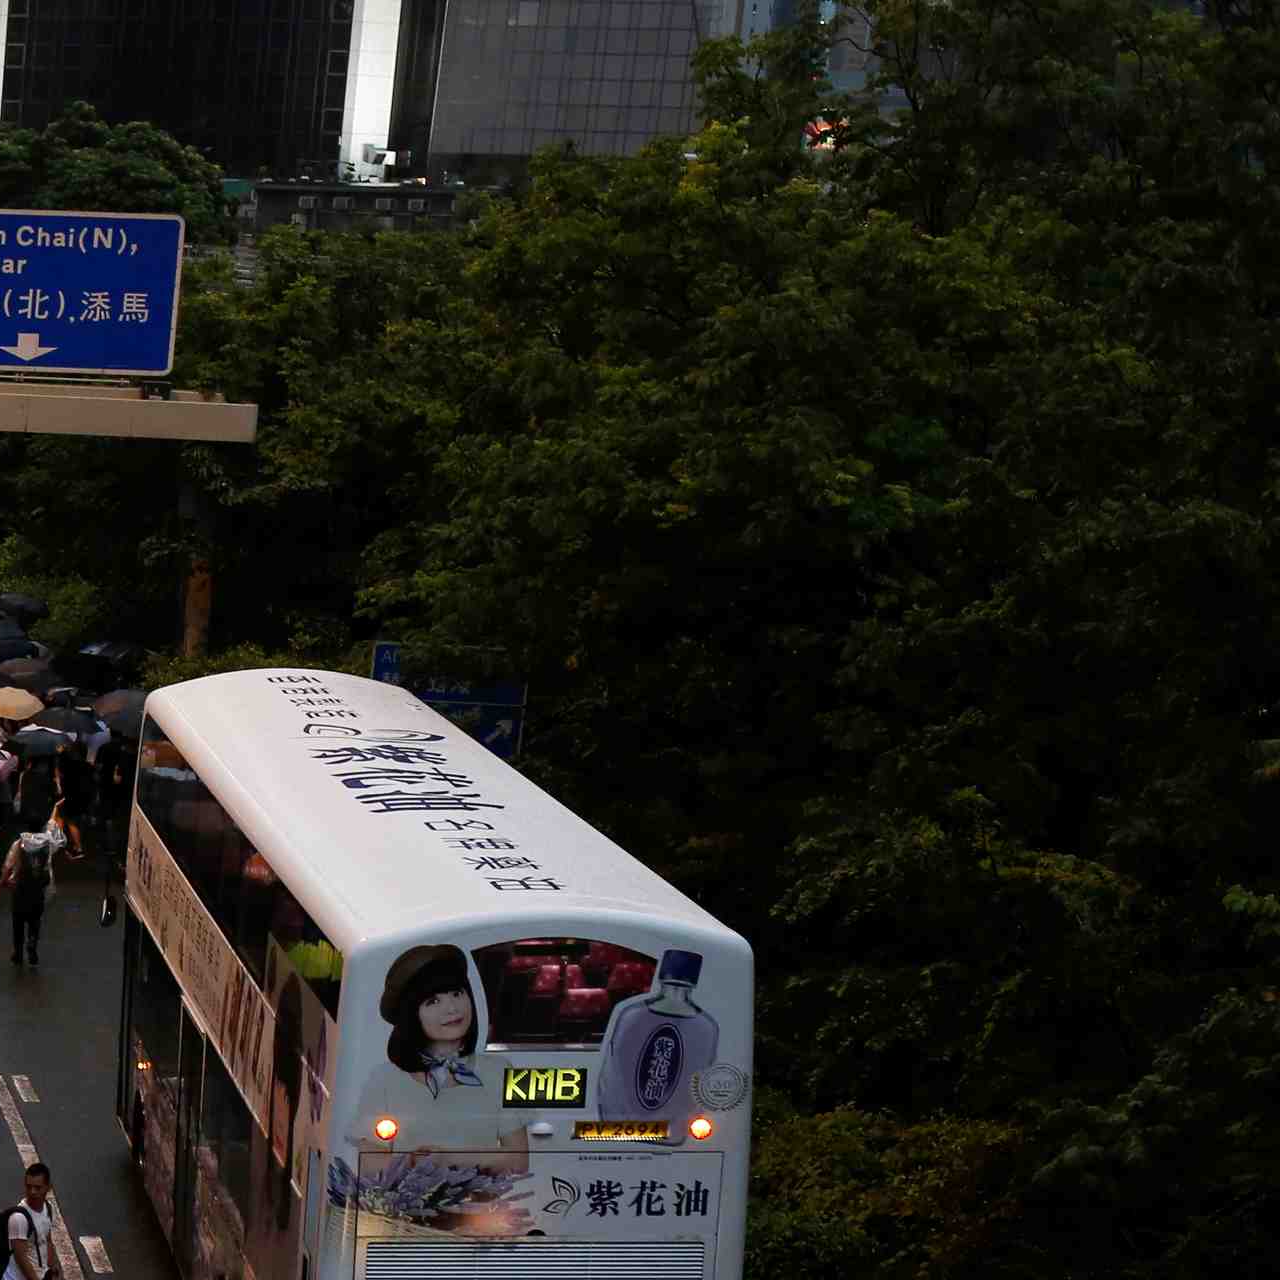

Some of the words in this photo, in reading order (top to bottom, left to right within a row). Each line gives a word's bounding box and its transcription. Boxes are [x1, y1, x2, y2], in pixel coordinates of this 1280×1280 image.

[505, 1067, 582, 1102] KMB
[585, 1179, 709, 1217] 紫花油
